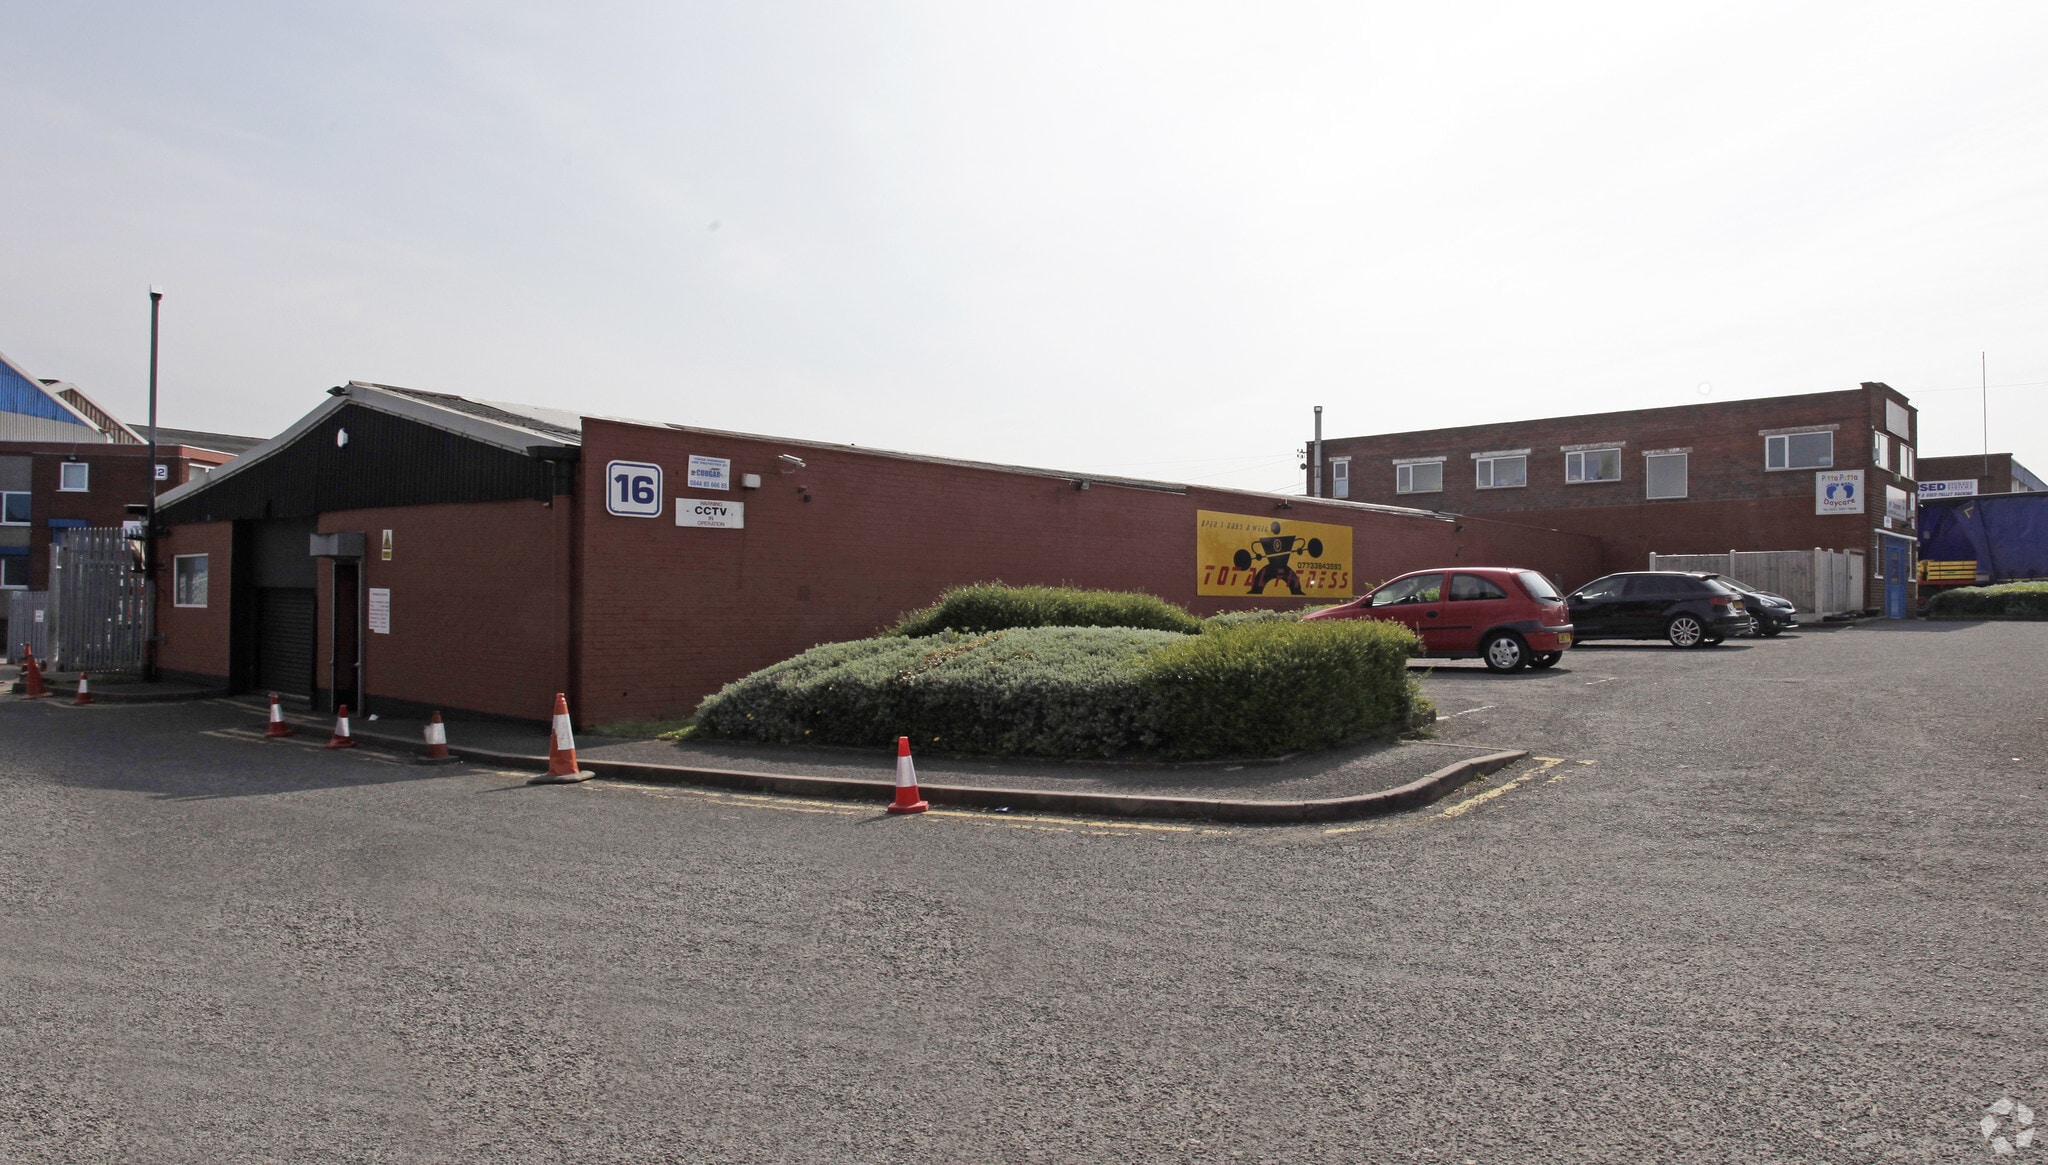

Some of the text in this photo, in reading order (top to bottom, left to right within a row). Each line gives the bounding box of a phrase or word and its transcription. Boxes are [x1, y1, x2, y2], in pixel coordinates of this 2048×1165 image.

[696, 469, 721, 478] COUGAR
[614, 474, 655, 504] 16
[1823, 498, 1856, 507] Daycare
[694, 506, 727, 516] CCTV
[1204, 565, 1348, 589] TOTAL FITNESS
